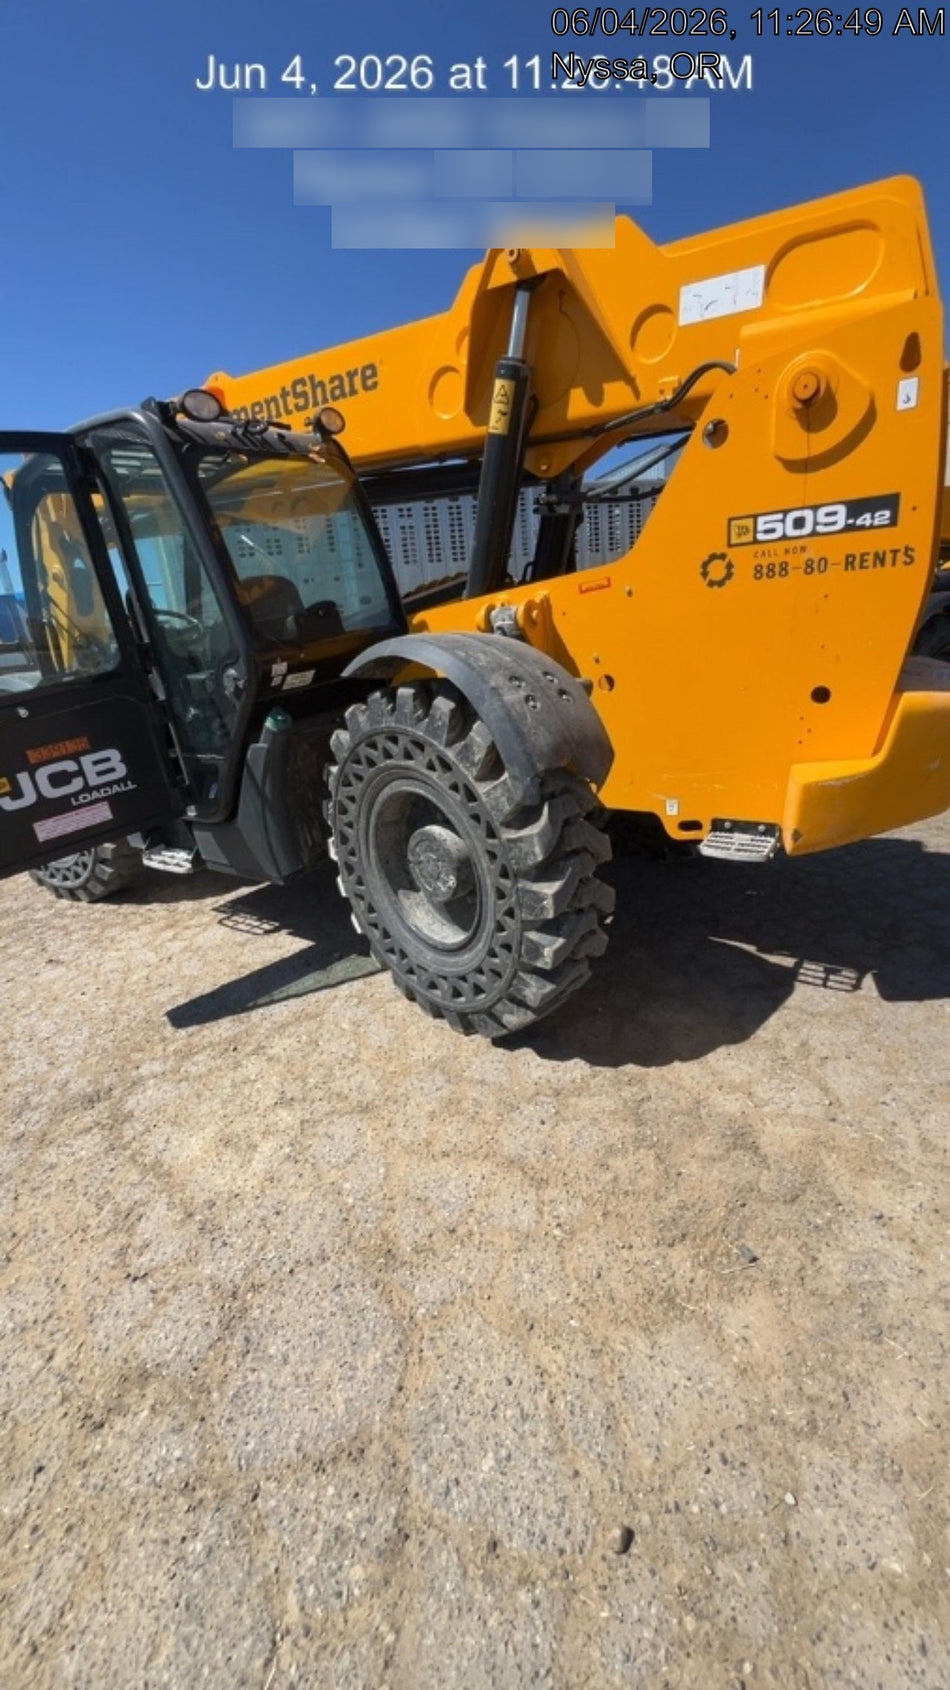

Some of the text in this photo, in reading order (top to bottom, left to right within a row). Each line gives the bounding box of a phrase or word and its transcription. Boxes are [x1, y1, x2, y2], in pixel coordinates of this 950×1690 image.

[756, 504, 892, 542] 509-42
[753, 546, 807, 559] CALL NOW
[0, 748, 127, 812] JCB
[71, 781, 137, 806] LOADALL
